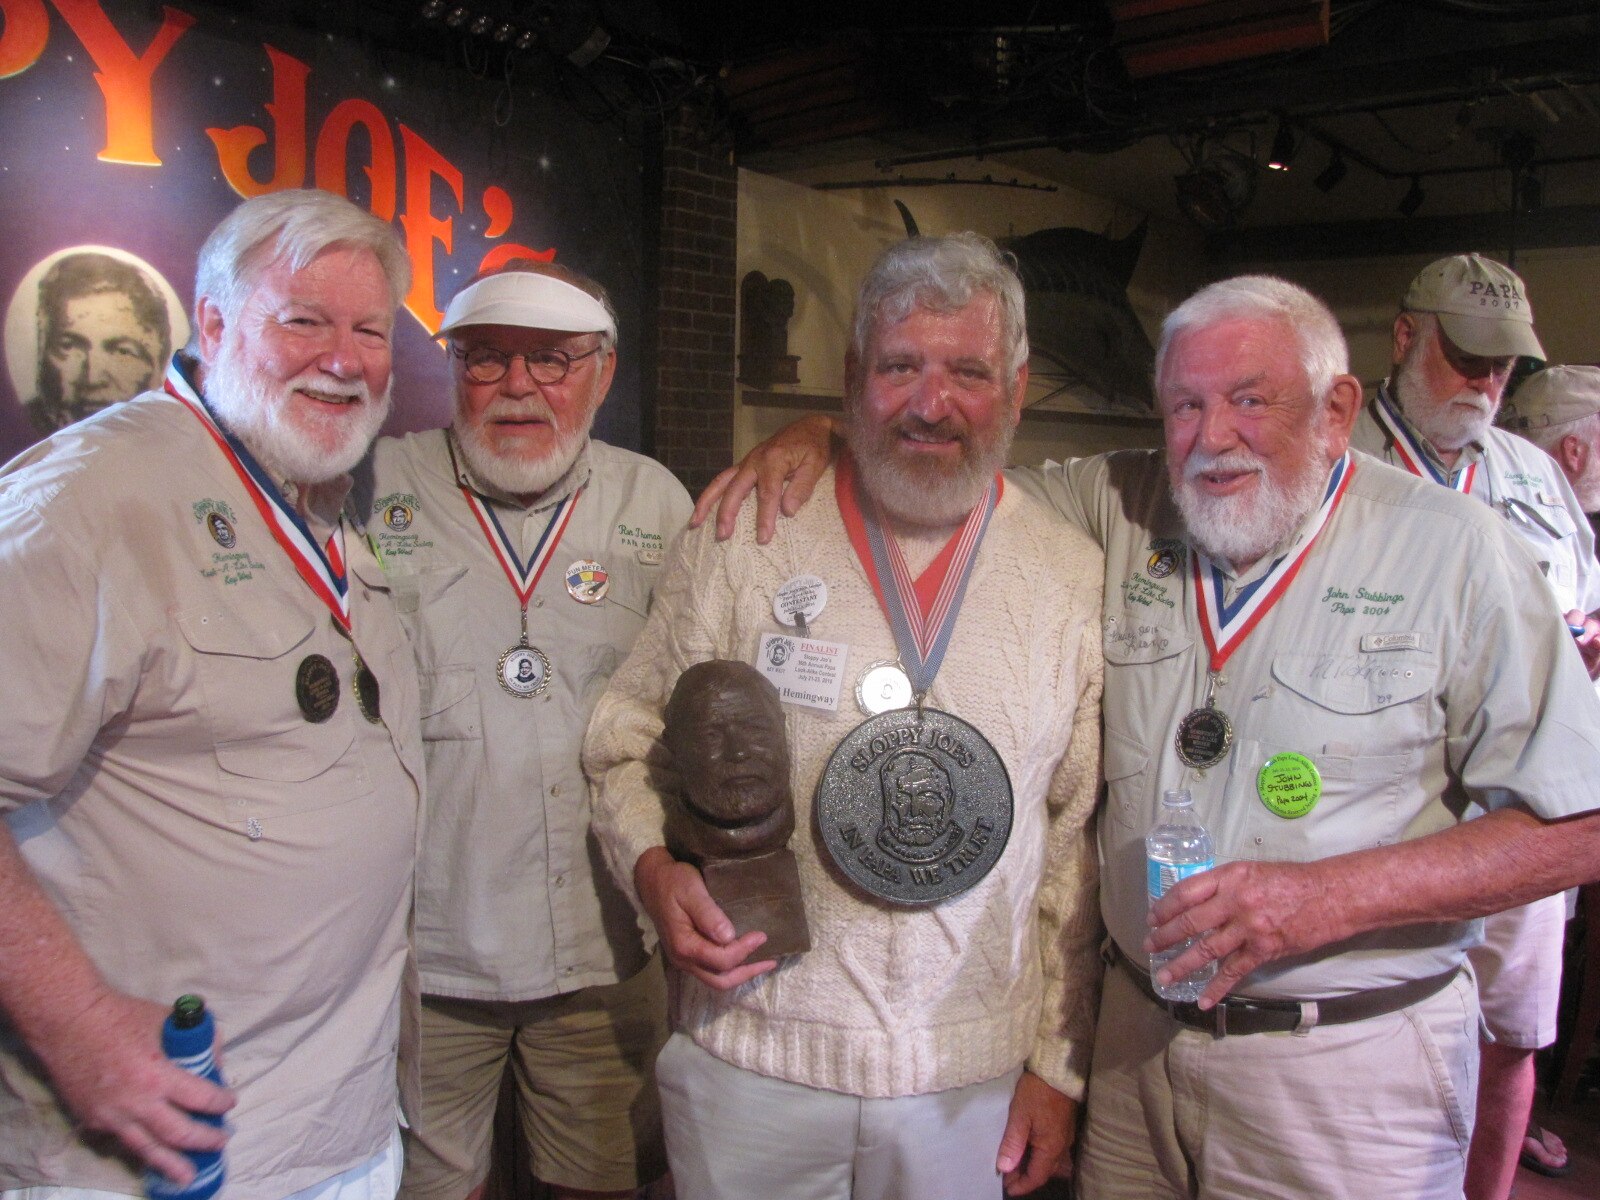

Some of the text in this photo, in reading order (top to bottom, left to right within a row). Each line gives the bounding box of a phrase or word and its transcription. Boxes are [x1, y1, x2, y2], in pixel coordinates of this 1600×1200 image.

[205, 43, 556, 350] JOE'
[1470, 281, 1522, 300] PAPA
[1479, 298, 1520, 309] 2007
[635, 527, 662, 541] Thomas
[641, 542, 664, 550] 2002
[1322, 586, 1405, 604] John Stubbings
[1331, 602, 1391, 616] Papa 2004
[801, 643, 838, 656] FINALIST
[783, 687, 835, 706] Hemingway
[850, 727, 923, 773] SLOPPY
[1274, 773, 1302, 784] JOHN
[909, 864, 943, 885] WE
[944, 816, 994, 874] TRUST
